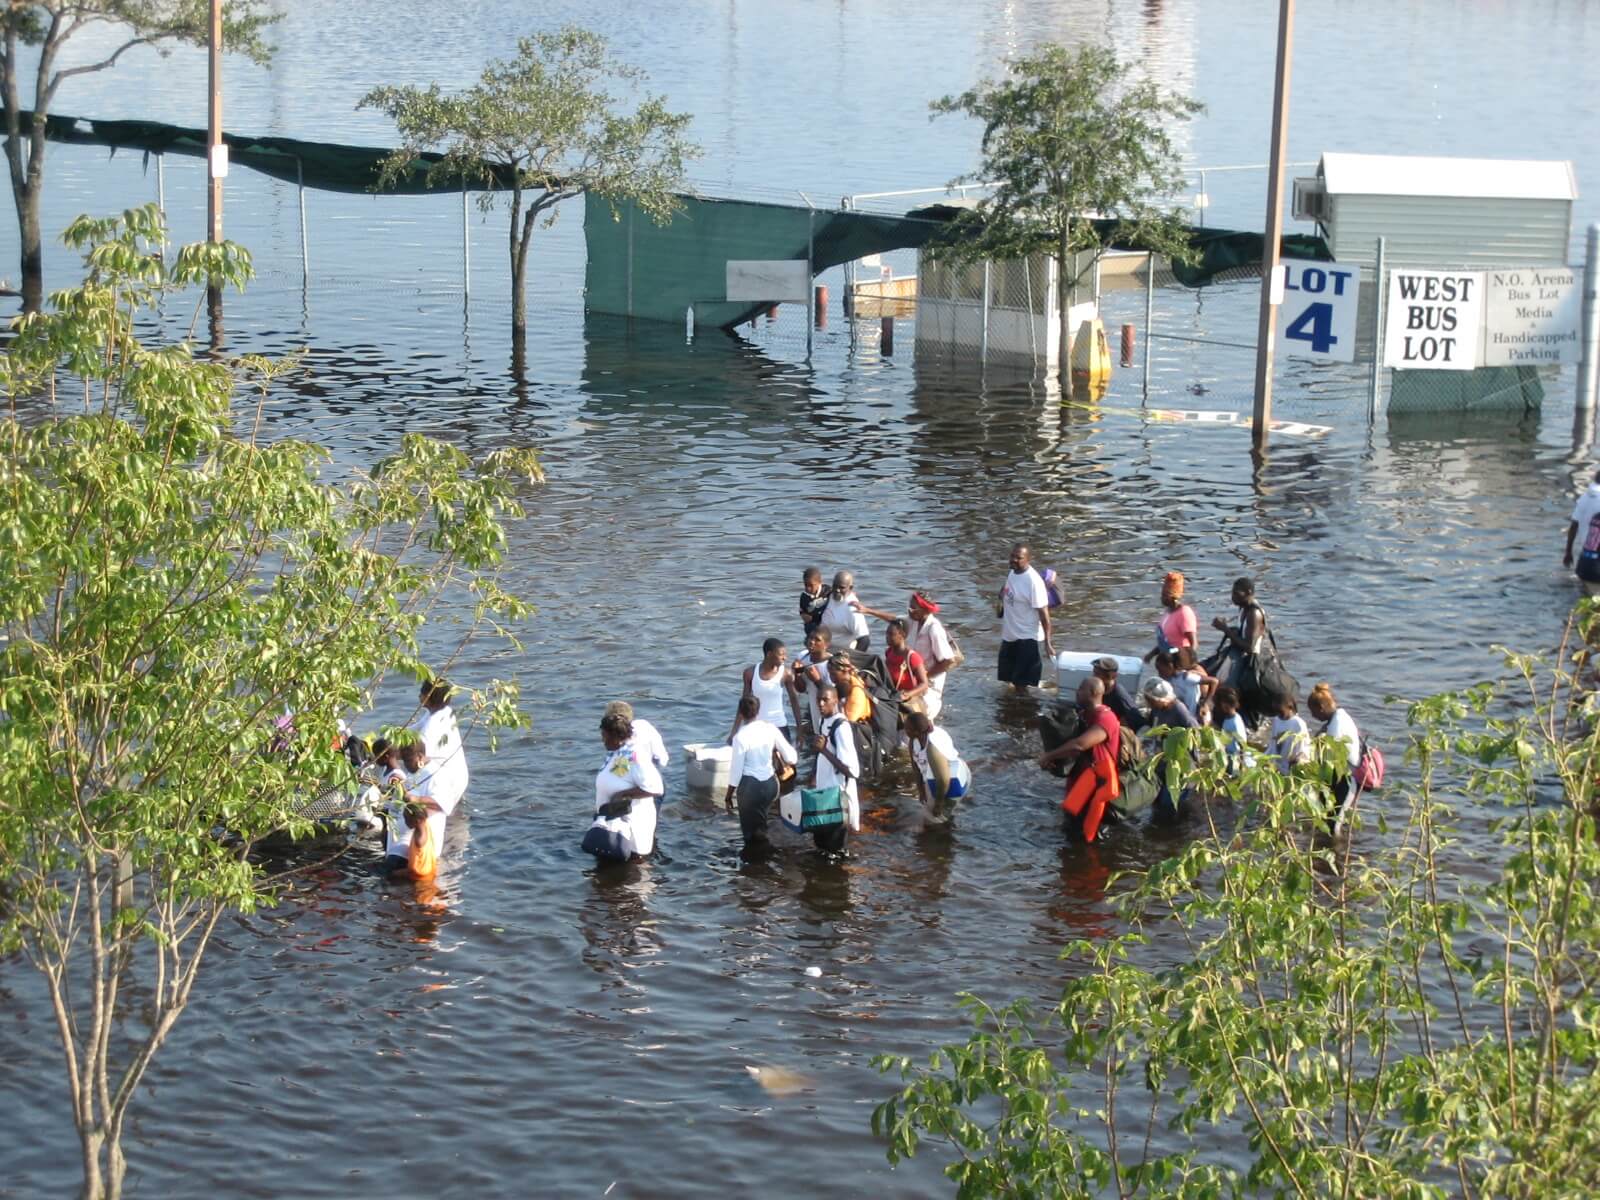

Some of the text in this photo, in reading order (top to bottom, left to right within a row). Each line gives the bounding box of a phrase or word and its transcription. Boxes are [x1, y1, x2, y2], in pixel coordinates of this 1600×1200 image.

[1285, 265, 1352, 296] LOT
[1398, 275, 1474, 302] WEST
[1494, 273, 1574, 287] N.O. Arena
[1508, 288, 1559, 300] Bus Lot
[1406, 305, 1457, 331] BUS
[1515, 307, 1553, 319] Media
[1285, 302, 1338, 353] 4
[1493, 330, 1576, 344] Handicapped
[1403, 336, 1457, 362] LOT
[1508, 348, 1560, 361] Parking
